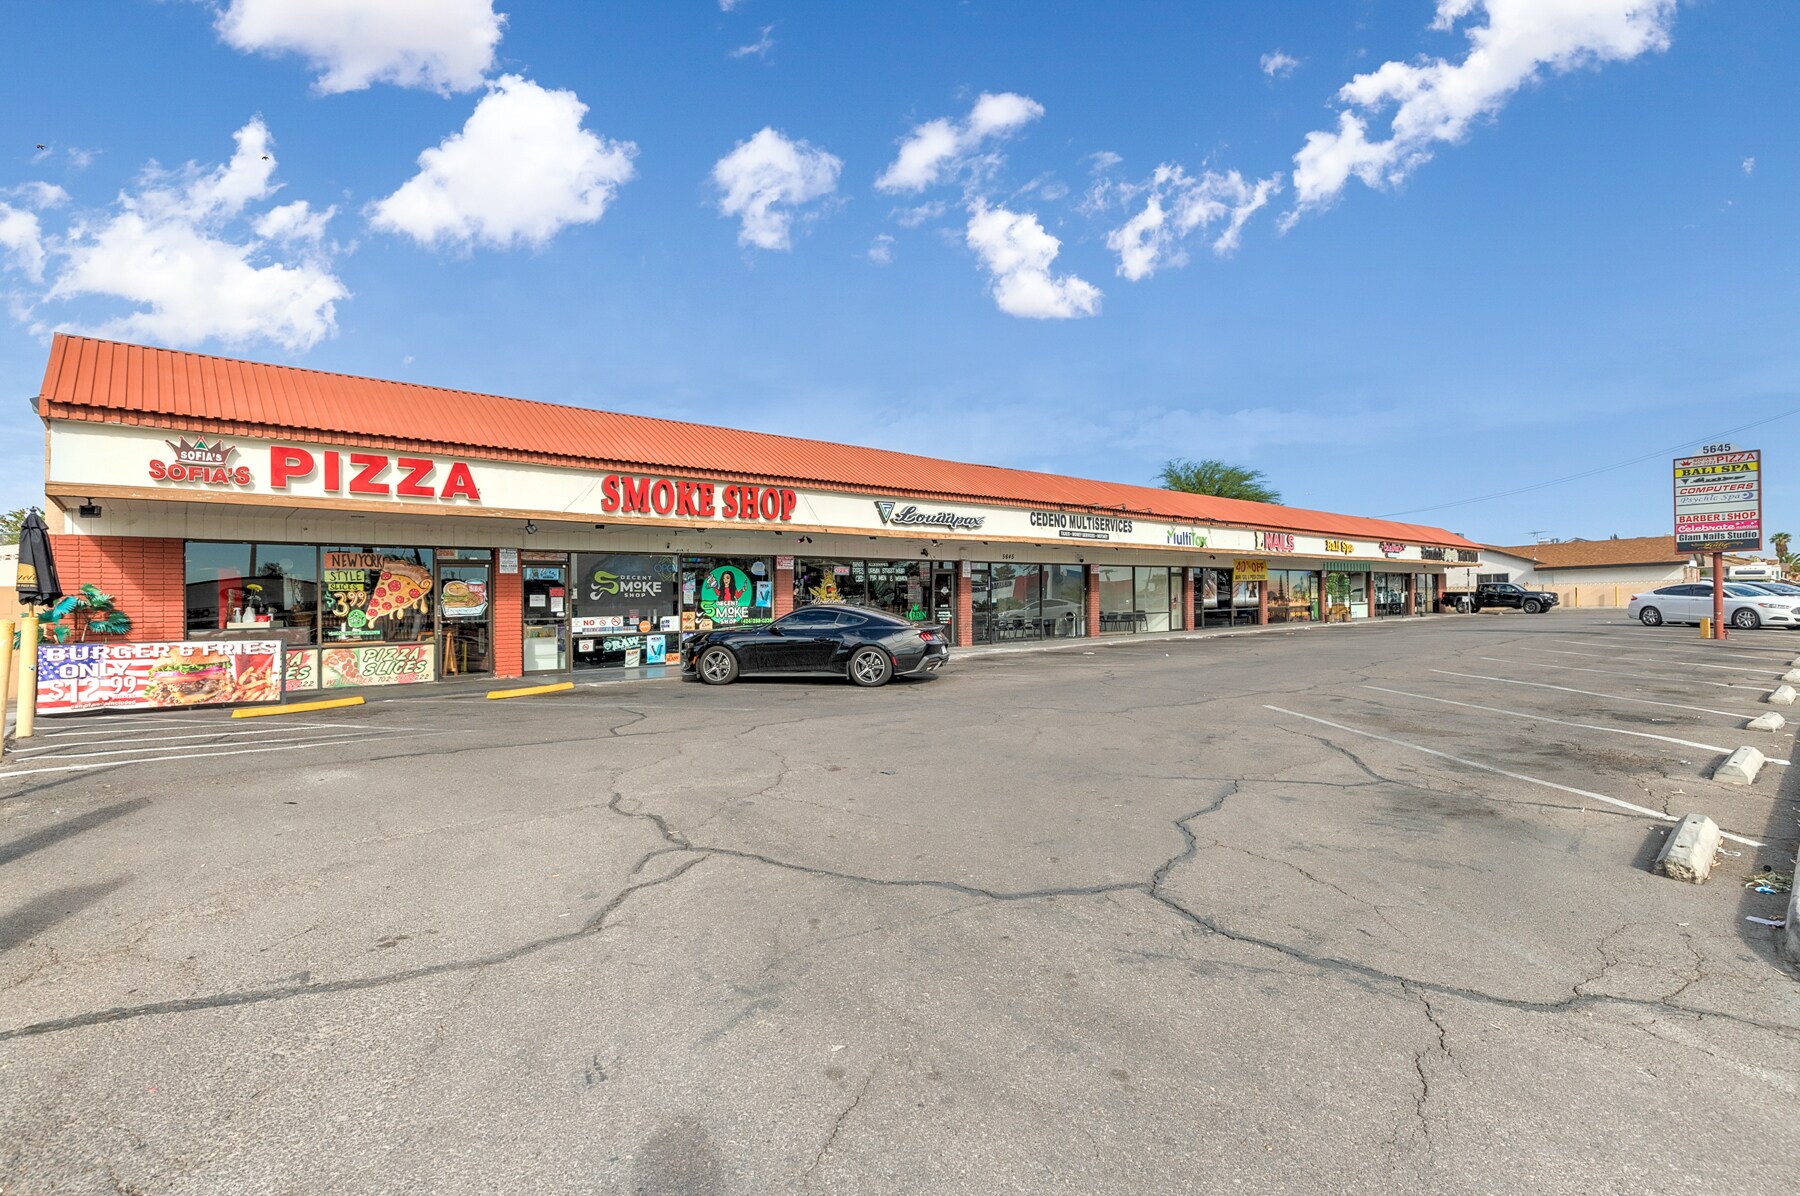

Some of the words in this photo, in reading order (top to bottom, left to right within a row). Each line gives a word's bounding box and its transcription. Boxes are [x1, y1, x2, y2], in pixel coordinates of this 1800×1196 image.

[181, 451, 222, 461] SOFIA'S
[1703, 444, 1731, 454] 5645
[1716, 452, 1755, 463] PIZZA
[149, 459, 251, 485] SOFIA'S
[270, 445, 480, 500] PIZZA
[1682, 467, 1717, 476] BALI
[1721, 464, 1751, 473] SPA
[1680, 483, 1754, 494] COMPUTERS
[601, 474, 715, 516] SMOKE
[723, 484, 797, 520] SHOP
[1680, 494, 1718, 504] Psychic
[1720, 493, 1740, 502] Spa
[1030, 512, 1067, 528] CEDENO
[1069, 515, 1133, 533] MULTISERVICES
[1679, 513, 1720, 523] BARBER
[1727, 511, 1756, 520] SHOP
[1678, 523, 1735, 533] Celebrate
[1167, 525, 1208, 547] MultiTax
[1264, 532, 1295, 552] NAILS
[1679, 533, 1701, 541] Glam
[1703, 532, 1725, 540] Nails
[1727, 531, 1757, 539] Studio
[1326, 540, 1340, 551] Bali
[1341, 541, 1354, 555] Spa
[332, 554, 359, 567] NEW
[359, 554, 385, 568] YORK
[654, 563, 678, 573] OPEN
[1252, 562, 1264, 572] OFF
[329, 570, 363, 581] STYLE
[612, 636, 640, 651] RAW
[46, 645, 170, 662] BURGER
[180, 645, 194, 657] &
[202, 642, 276, 657] FRIES
[362, 646, 421, 663] PIZZA
[60, 662, 132, 679] ONLY
[362, 660, 427, 677] SLICES
